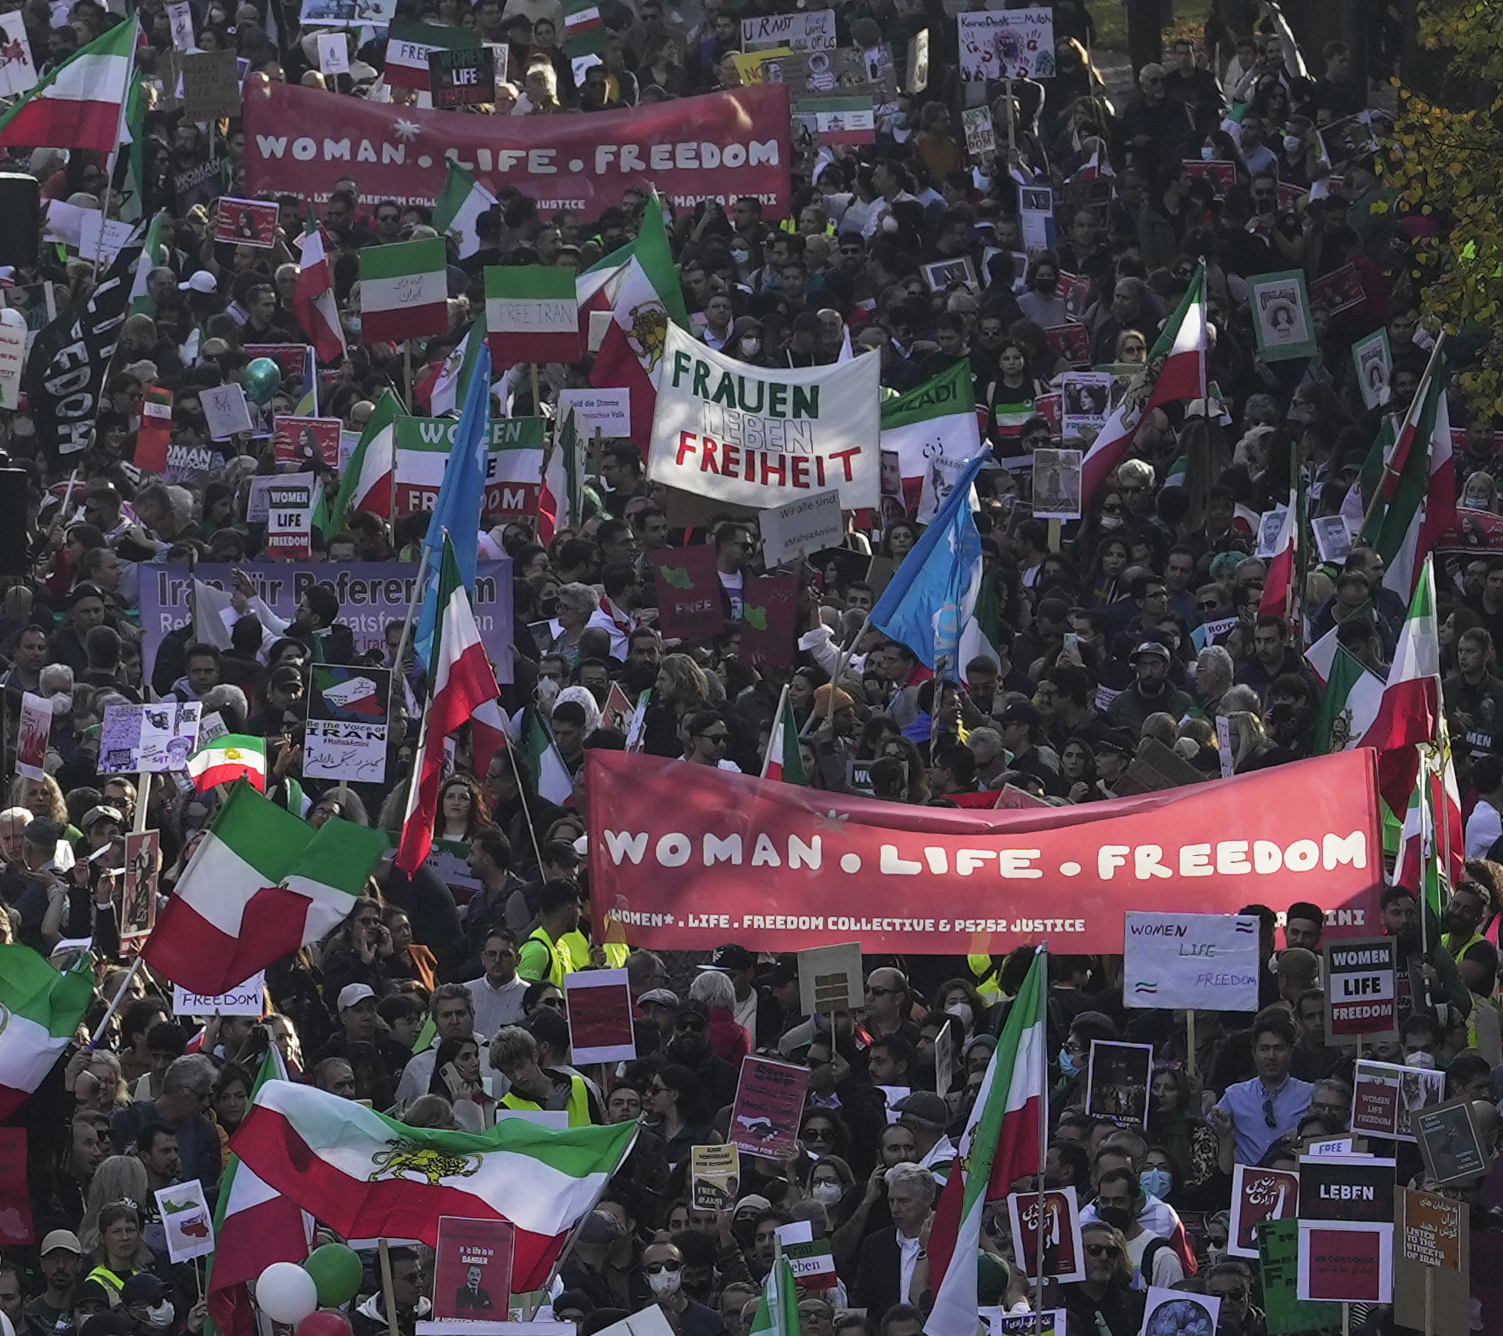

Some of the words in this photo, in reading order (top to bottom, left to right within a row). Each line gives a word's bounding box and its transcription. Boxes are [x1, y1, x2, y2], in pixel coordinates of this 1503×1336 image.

[255, 133, 401, 164] WOMAN
[595, 140, 780, 173] FREEDOM
[672, 348, 820, 420] FRAUEN
[701, 401, 814, 455] LEBEN
[675, 429, 862, 489] FREIHEIT
[603, 827, 824, 872] WOMAN
[881, 841, 1043, 879] LIFE
[1098, 829, 1369, 878] FREEDOM
[688, 912, 733, 929] LIFE
[743, 912, 823, 930] FREEDOM
[827, 915, 936, 932] COLLECTIVE
[1009, 917, 1087, 934] JUSTICE
[1331, 948, 1390, 967] WOMEN
[1342, 976, 1382, 996] LIFE
[1332, 1004, 1392, 1021] FREEDOM
